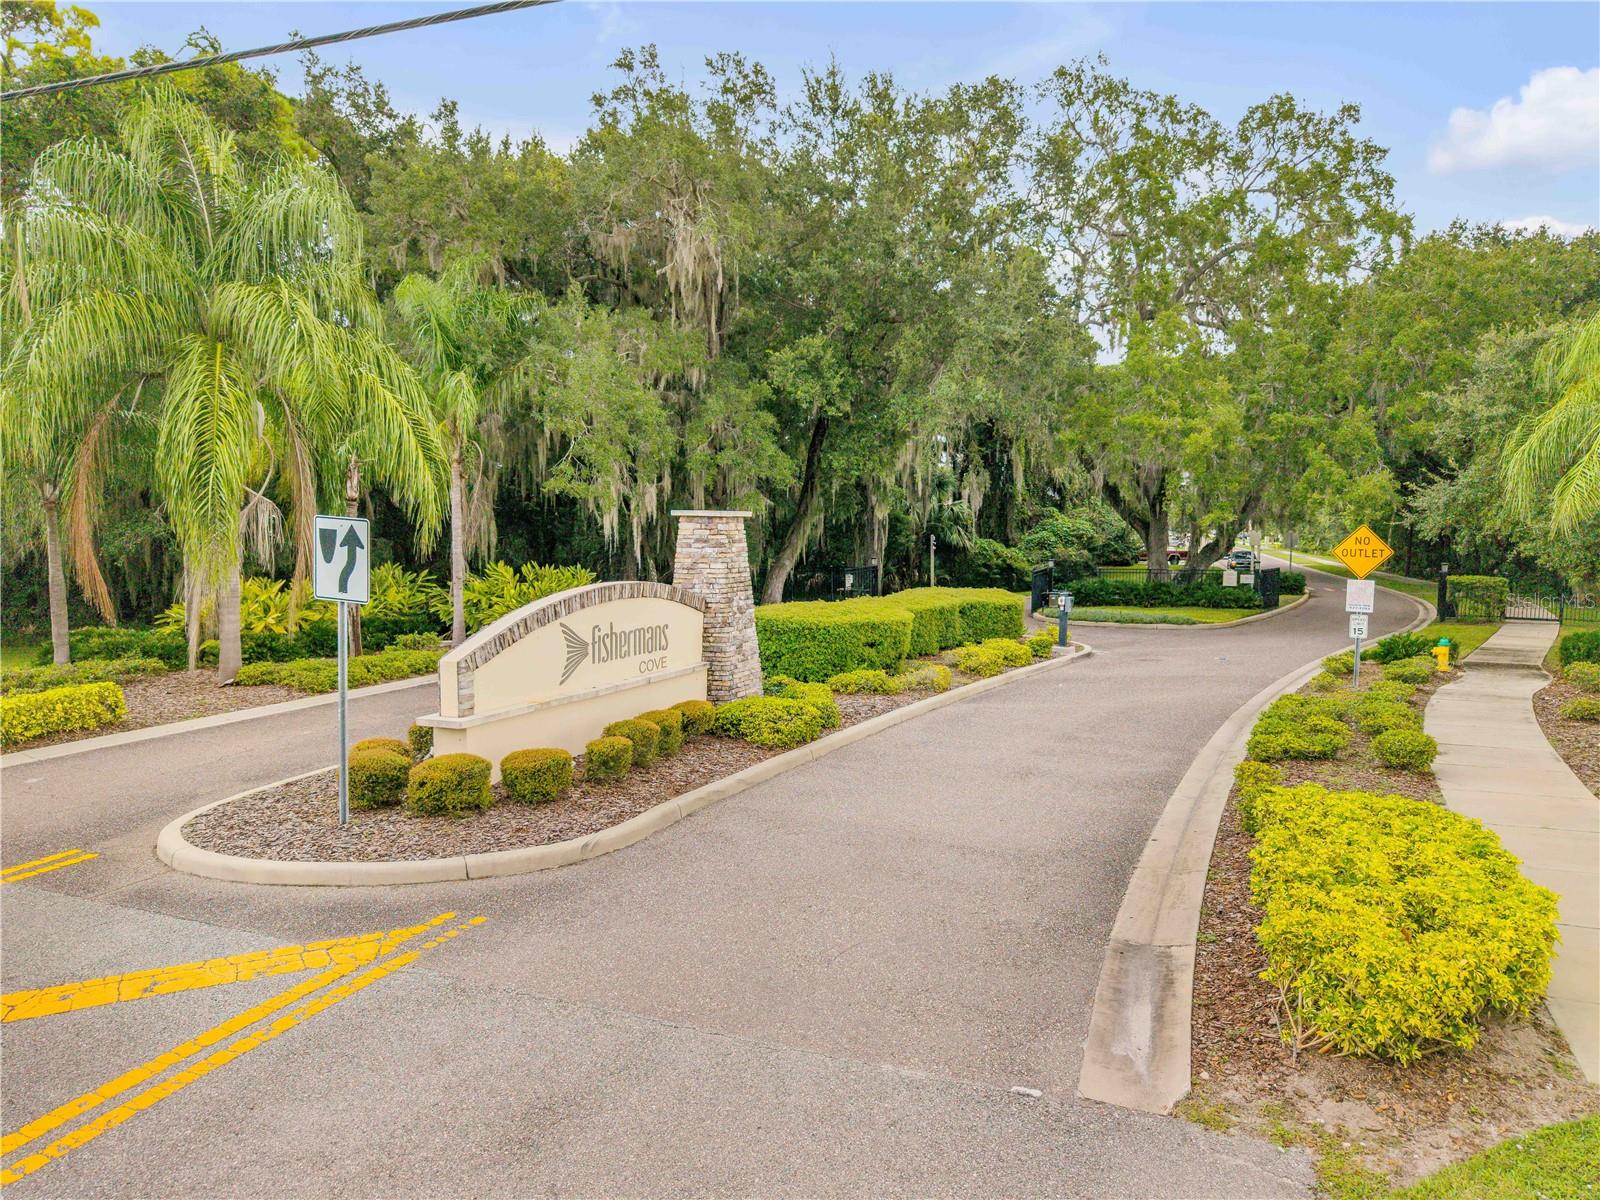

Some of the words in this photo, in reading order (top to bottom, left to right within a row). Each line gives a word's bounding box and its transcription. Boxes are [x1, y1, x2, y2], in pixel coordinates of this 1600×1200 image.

[1355, 536, 1371, 546] NO
[1341, 548, 1385, 558] OUTLET
[1353, 627, 1364, 636] 15
[591, 621, 669, 664] fishermans
[638, 656, 668, 674] COVE
